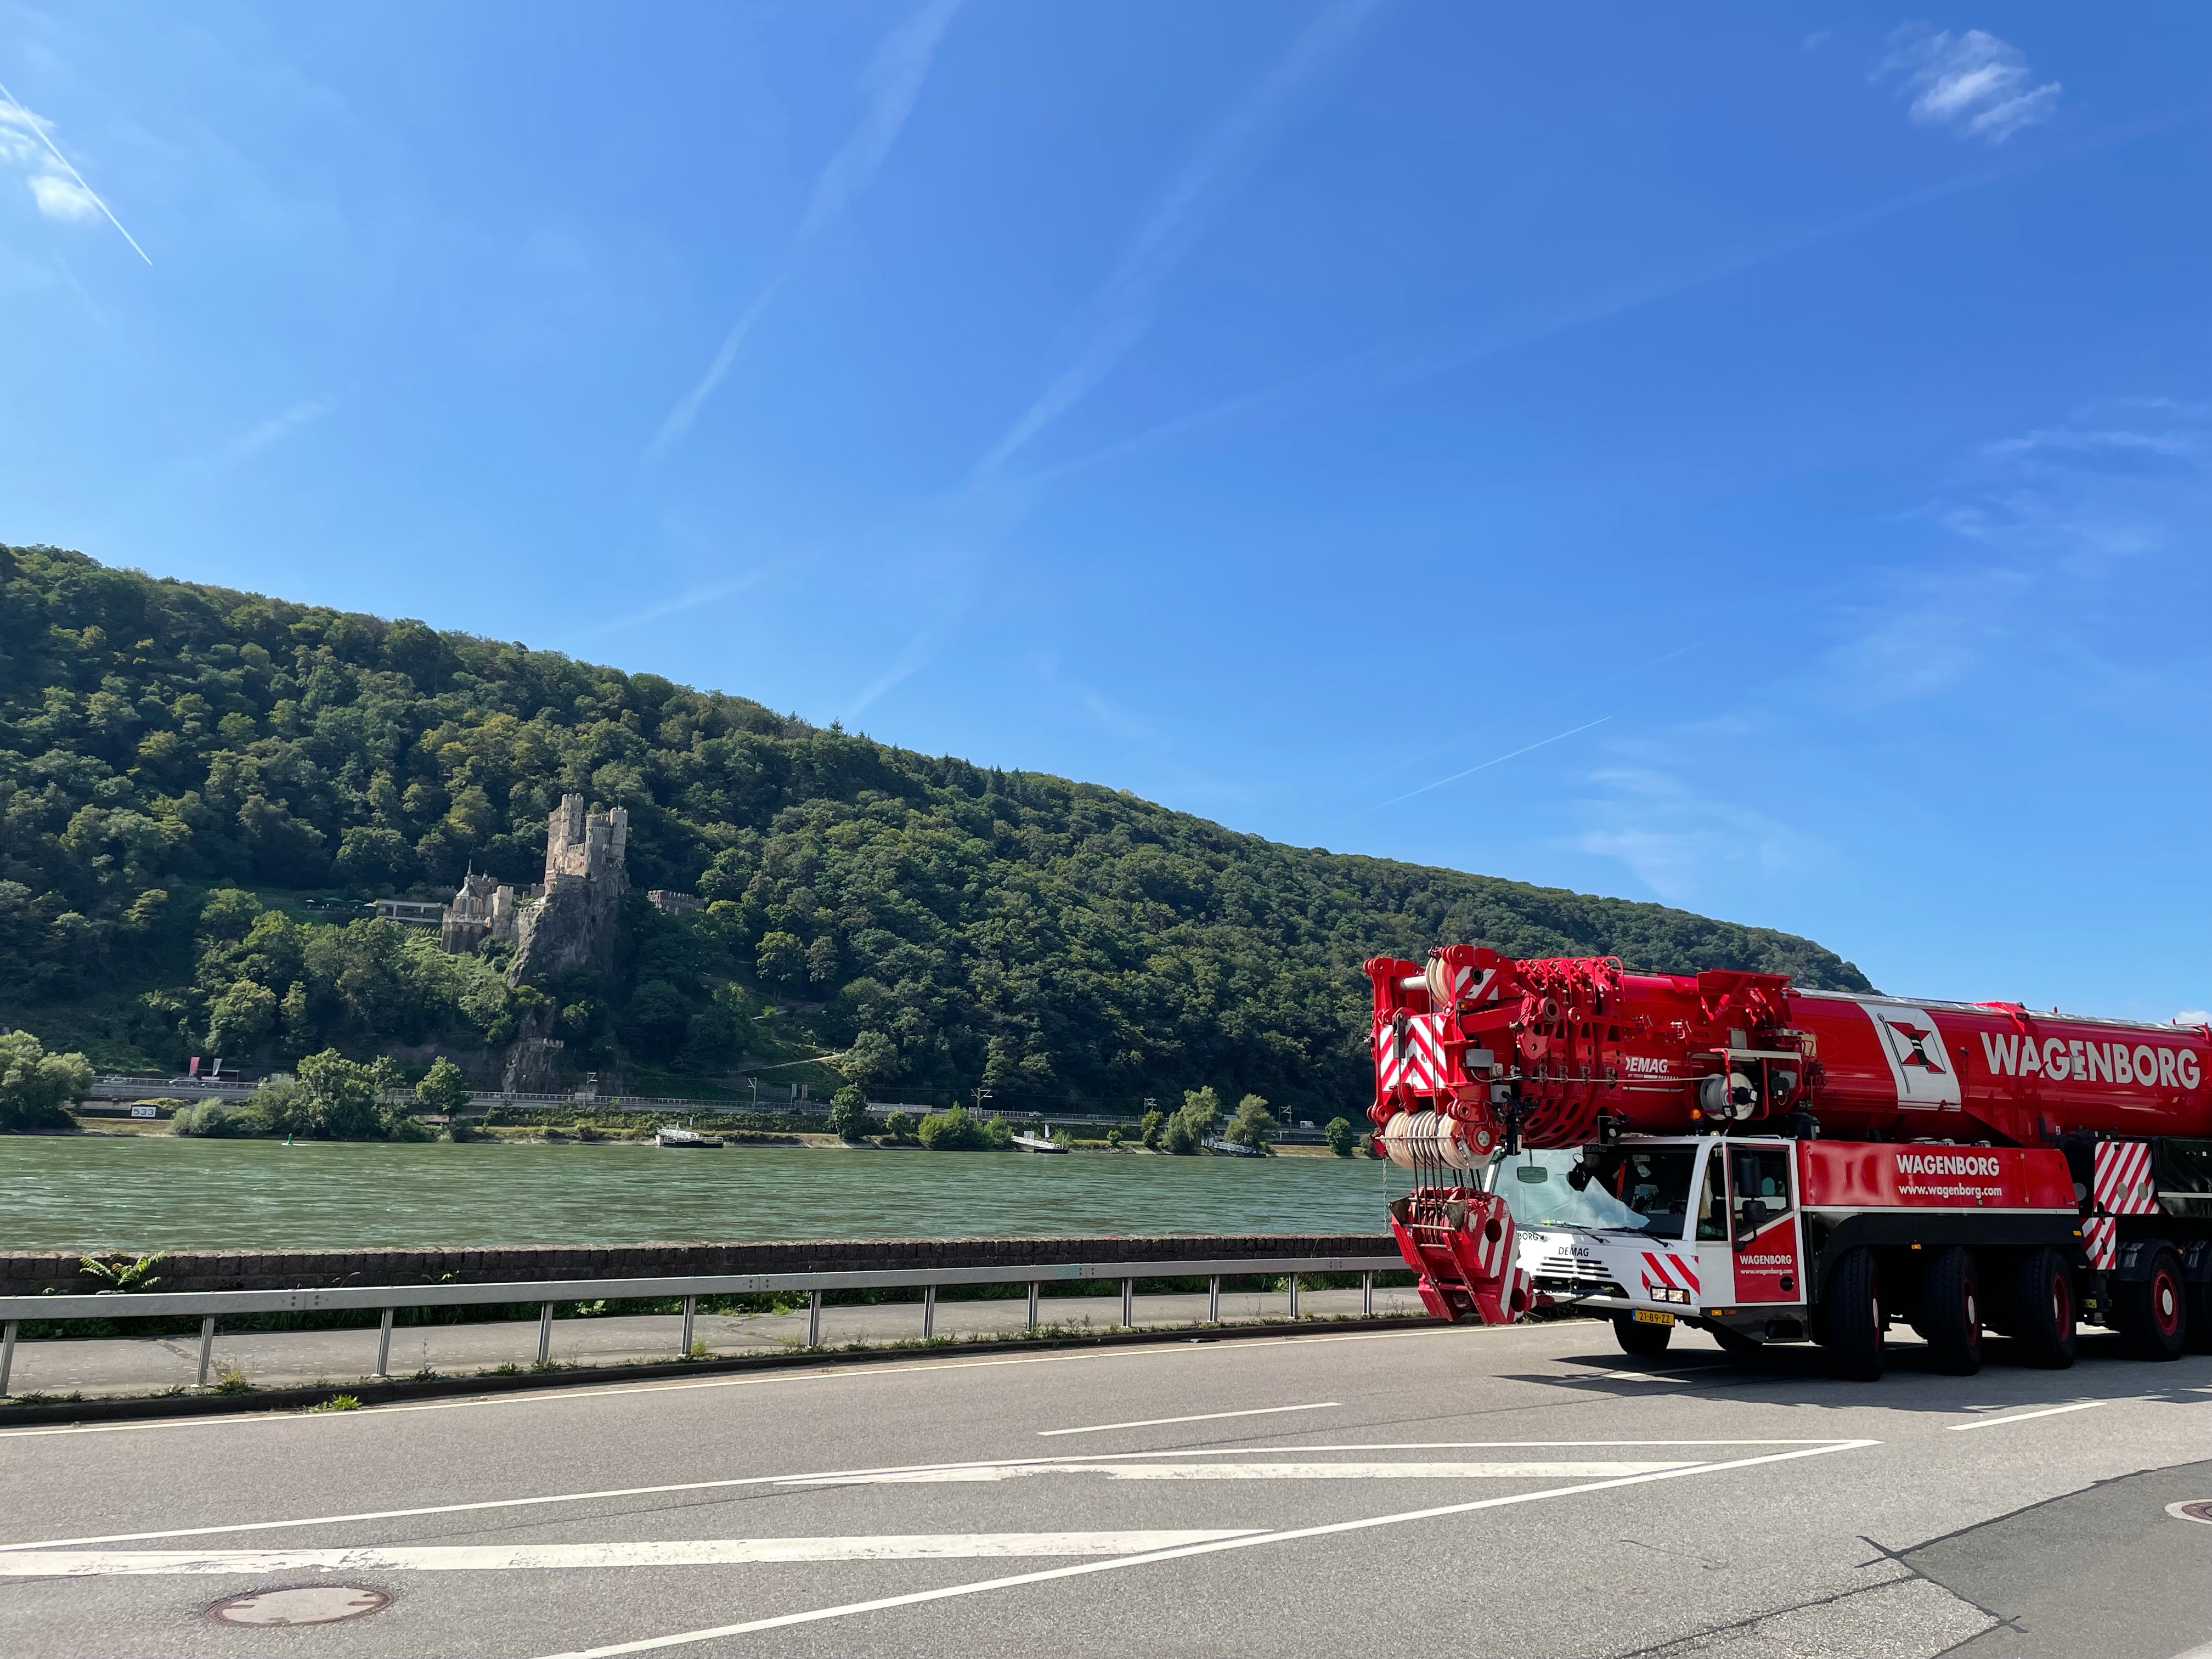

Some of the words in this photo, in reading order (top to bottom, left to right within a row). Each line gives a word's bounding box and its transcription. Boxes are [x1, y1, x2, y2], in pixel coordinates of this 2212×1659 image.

[1980, 1031, 2200, 1090] WAGENBORG
[1896, 1154, 2000, 1176] WAGENBORG
[1898, 1182, 2002, 1199] www.wagenborg.com
[1558, 1246, 1589, 1256] DEMAG
[1740, 1255, 1792, 1265] WAGENBORG
[1740, 1267, 1793, 1276] www.wagenborg.com
[1639, 1312, 1670, 1323] 21-89-ZZ
